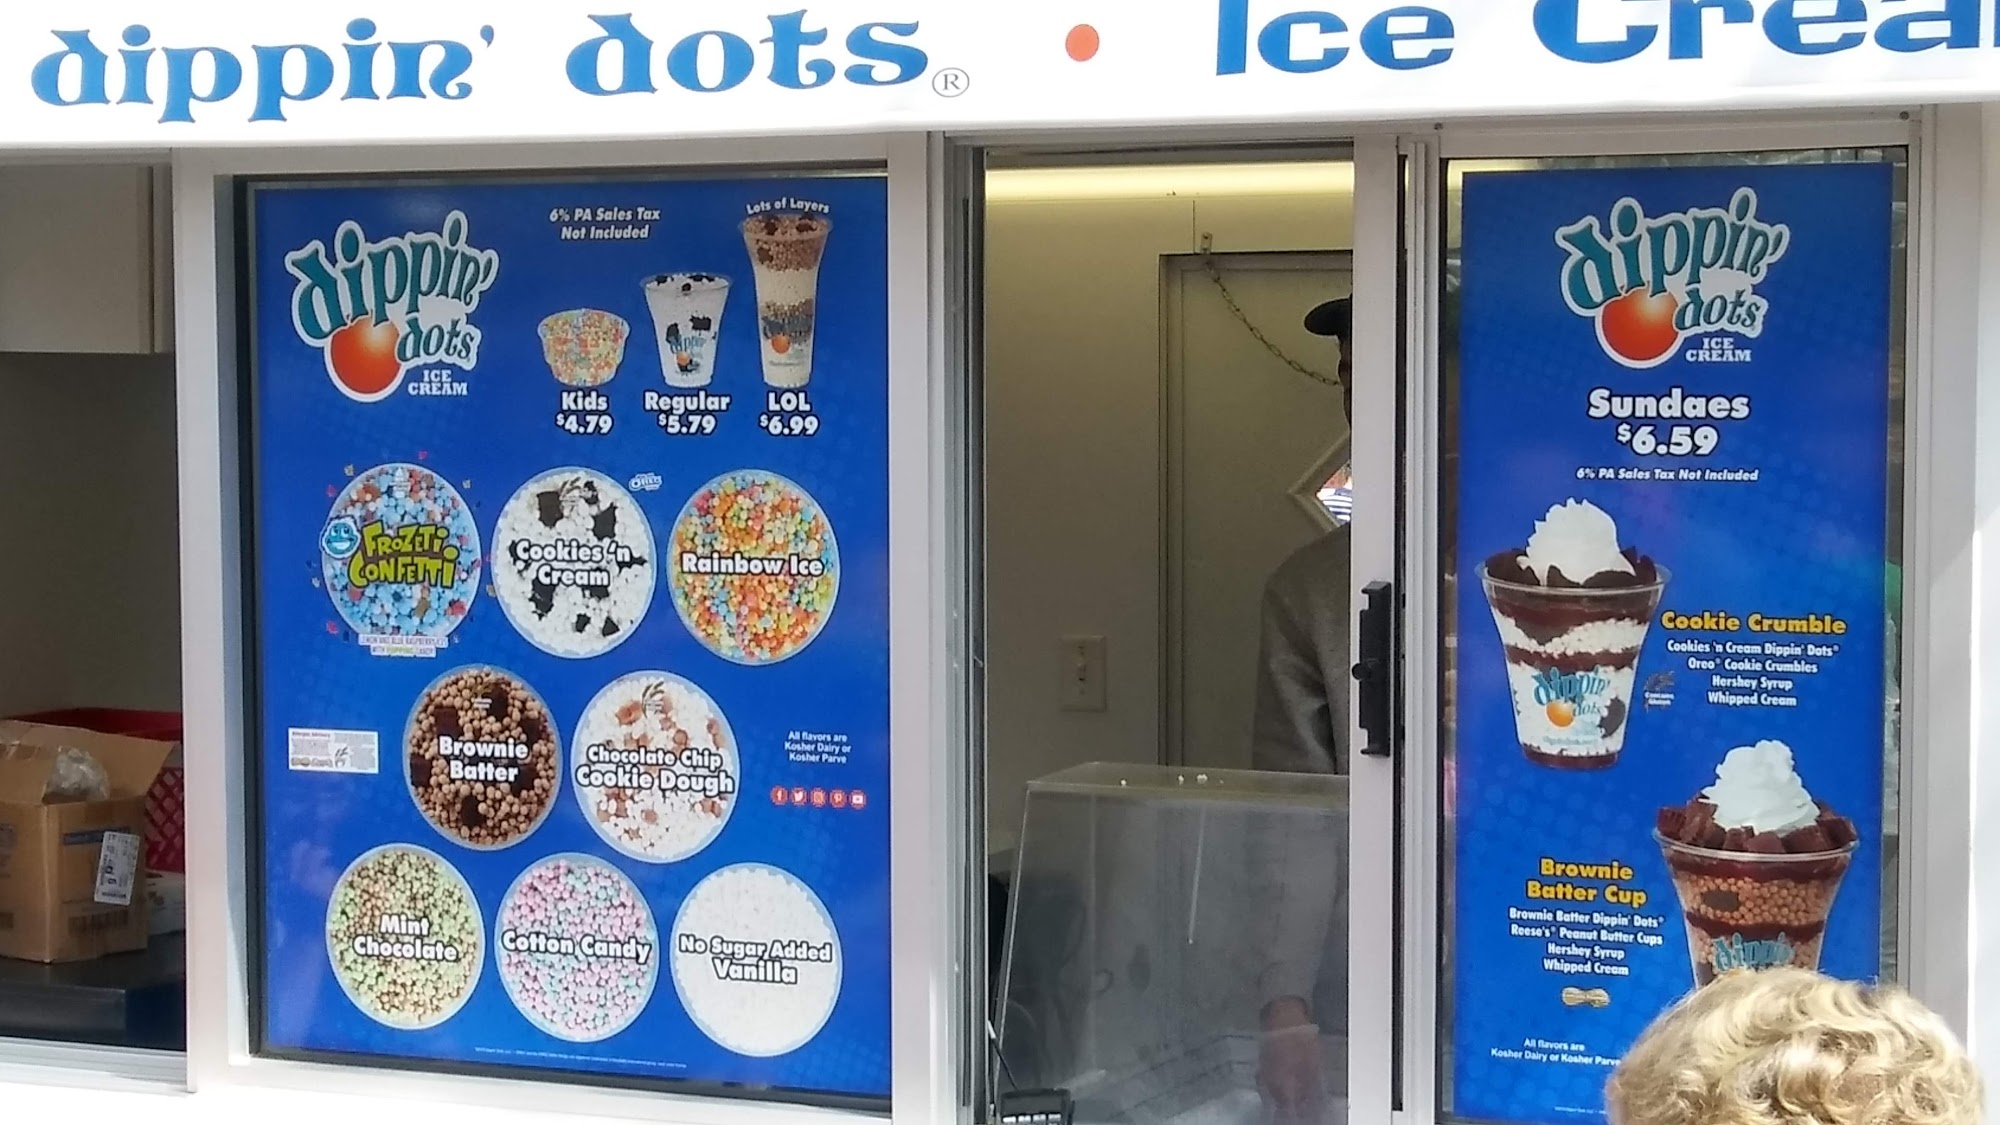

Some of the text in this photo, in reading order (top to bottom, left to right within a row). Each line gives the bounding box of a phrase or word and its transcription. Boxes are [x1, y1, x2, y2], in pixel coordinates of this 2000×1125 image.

[30, 17, 496, 124] dippin'
[1215, 0, 1456, 77] Ice
[1532, 0, 2000, 65] Crea
[549, 207, 661, 222] 6% PA Sales Tax
[746, 196, 830, 215] Lots of Layers
[560, 225, 650, 240] Not Included
[1560, 192, 1785, 311] dippin'
[290, 216, 494, 341] dippin'
[1674, 286, 1762, 332] dots
[400, 315, 476, 363] dots
[1702, 337, 1735, 350] ICE
[1685, 349, 1753, 363] CREAM
[422, 370, 452, 383] ICE
[407, 381, 469, 396] CREAM
[560, 391, 609, 412] Kids
[643, 391, 731, 414] Regular
[767, 391, 811, 412] LOL
[1587, 387, 1751, 419] Sundaes
[556, 413, 614, 434] $4.79
[658, 414, 717, 434] $5.79
[759, 415, 820, 436] $6.99
[1616, 422, 1720, 456] $6.59
[1576, 467, 1760, 482] 6% PA Sales Tax Not Included
[515, 539, 604, 563] Cookies
[681, 553, 825, 576] Rainbow Ice
[536, 565, 611, 588] Cream
[1660, 611, 1847, 634] Cookie Crumble
[1667, 639, 1711, 653] Cookies
[1725, 641, 1762, 654] Cream
[1764, 642, 1805, 657] Dippin'
[1724, 658, 1763, 671] Cookie
[1765, 660, 1819, 674] Crumbles
[1711, 675, 1793, 692] Hershey Syrup
[1707, 691, 1797, 707] Whipped Cream
[787, 730, 848, 743] All flavors are
[438, 735, 529, 760] Brownie
[587, 746, 724, 770] Chocolate Chip
[784, 741, 852, 754] Kosher Dairy or
[788, 751, 847, 764] Kosher Parve
[449, 760, 519, 782] Batter
[575, 767, 735, 796] Cookie Dough
[1540, 857, 1634, 880] Brownie
[1526, 880, 1647, 909] Batter Cup
[378, 913, 430, 937] Mint
[1509, 906, 1554, 921] Brownie
[1555, 909, 1591, 924] Batter
[1592, 911, 1632, 928] Dippin'
[501, 929, 651, 965] Cotton Candy
[1558, 926, 1599, 941] Peanut
[1600, 929, 1635, 943] Butter
[1636, 931, 1664, 947] Cups
[353, 934, 460, 962] Chocolate
[678, 933, 833, 963] No Sugar Added
[1547, 942, 1625, 961] Hershey Syrup
[711, 955, 798, 985] Vanilla
[1543, 958, 1630, 976] Whipped Cream
[1523, 1037, 1586, 1052] All flavors are
[1490, 1047, 1523, 1059] Kosher
[1524, 1050, 1548, 1063] Dairy
[1549, 1053, 1559, 1062] or
[1560, 1053, 1594, 1065] Kosher
